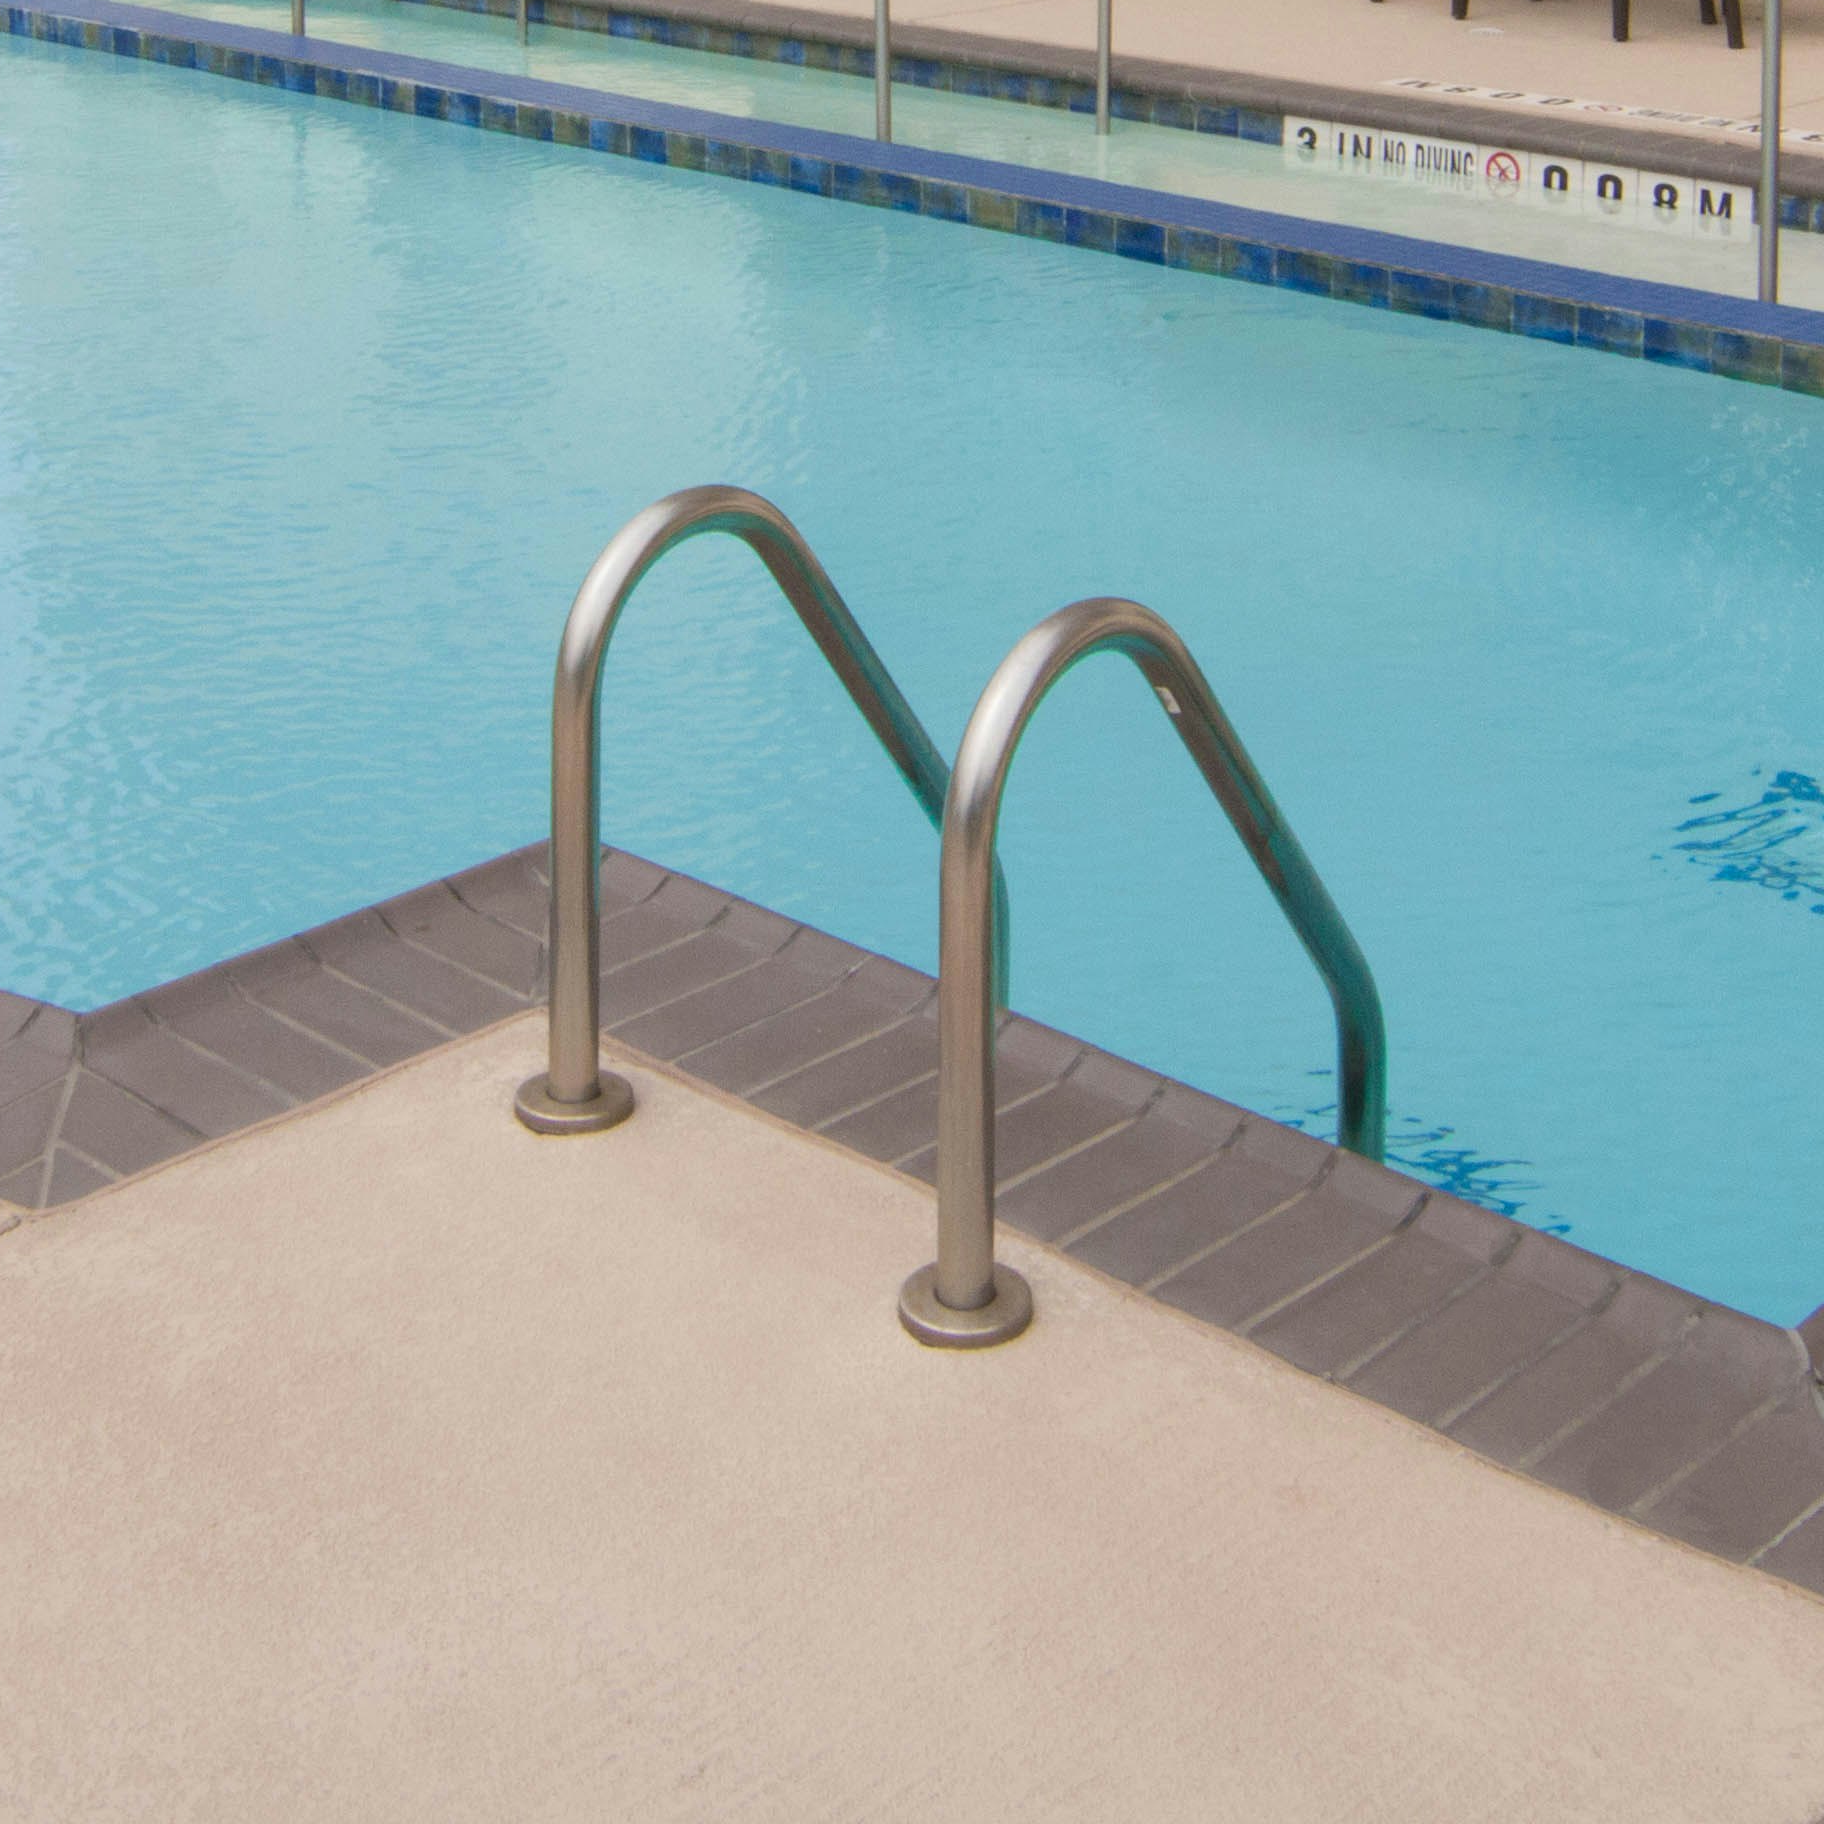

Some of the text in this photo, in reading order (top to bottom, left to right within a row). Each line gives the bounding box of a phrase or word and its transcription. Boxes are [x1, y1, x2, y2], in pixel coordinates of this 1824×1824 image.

[1338, 132, 1372, 159] IN
[1383, 138, 1406, 165] NO
[1415, 144, 1473, 175] DIVING
